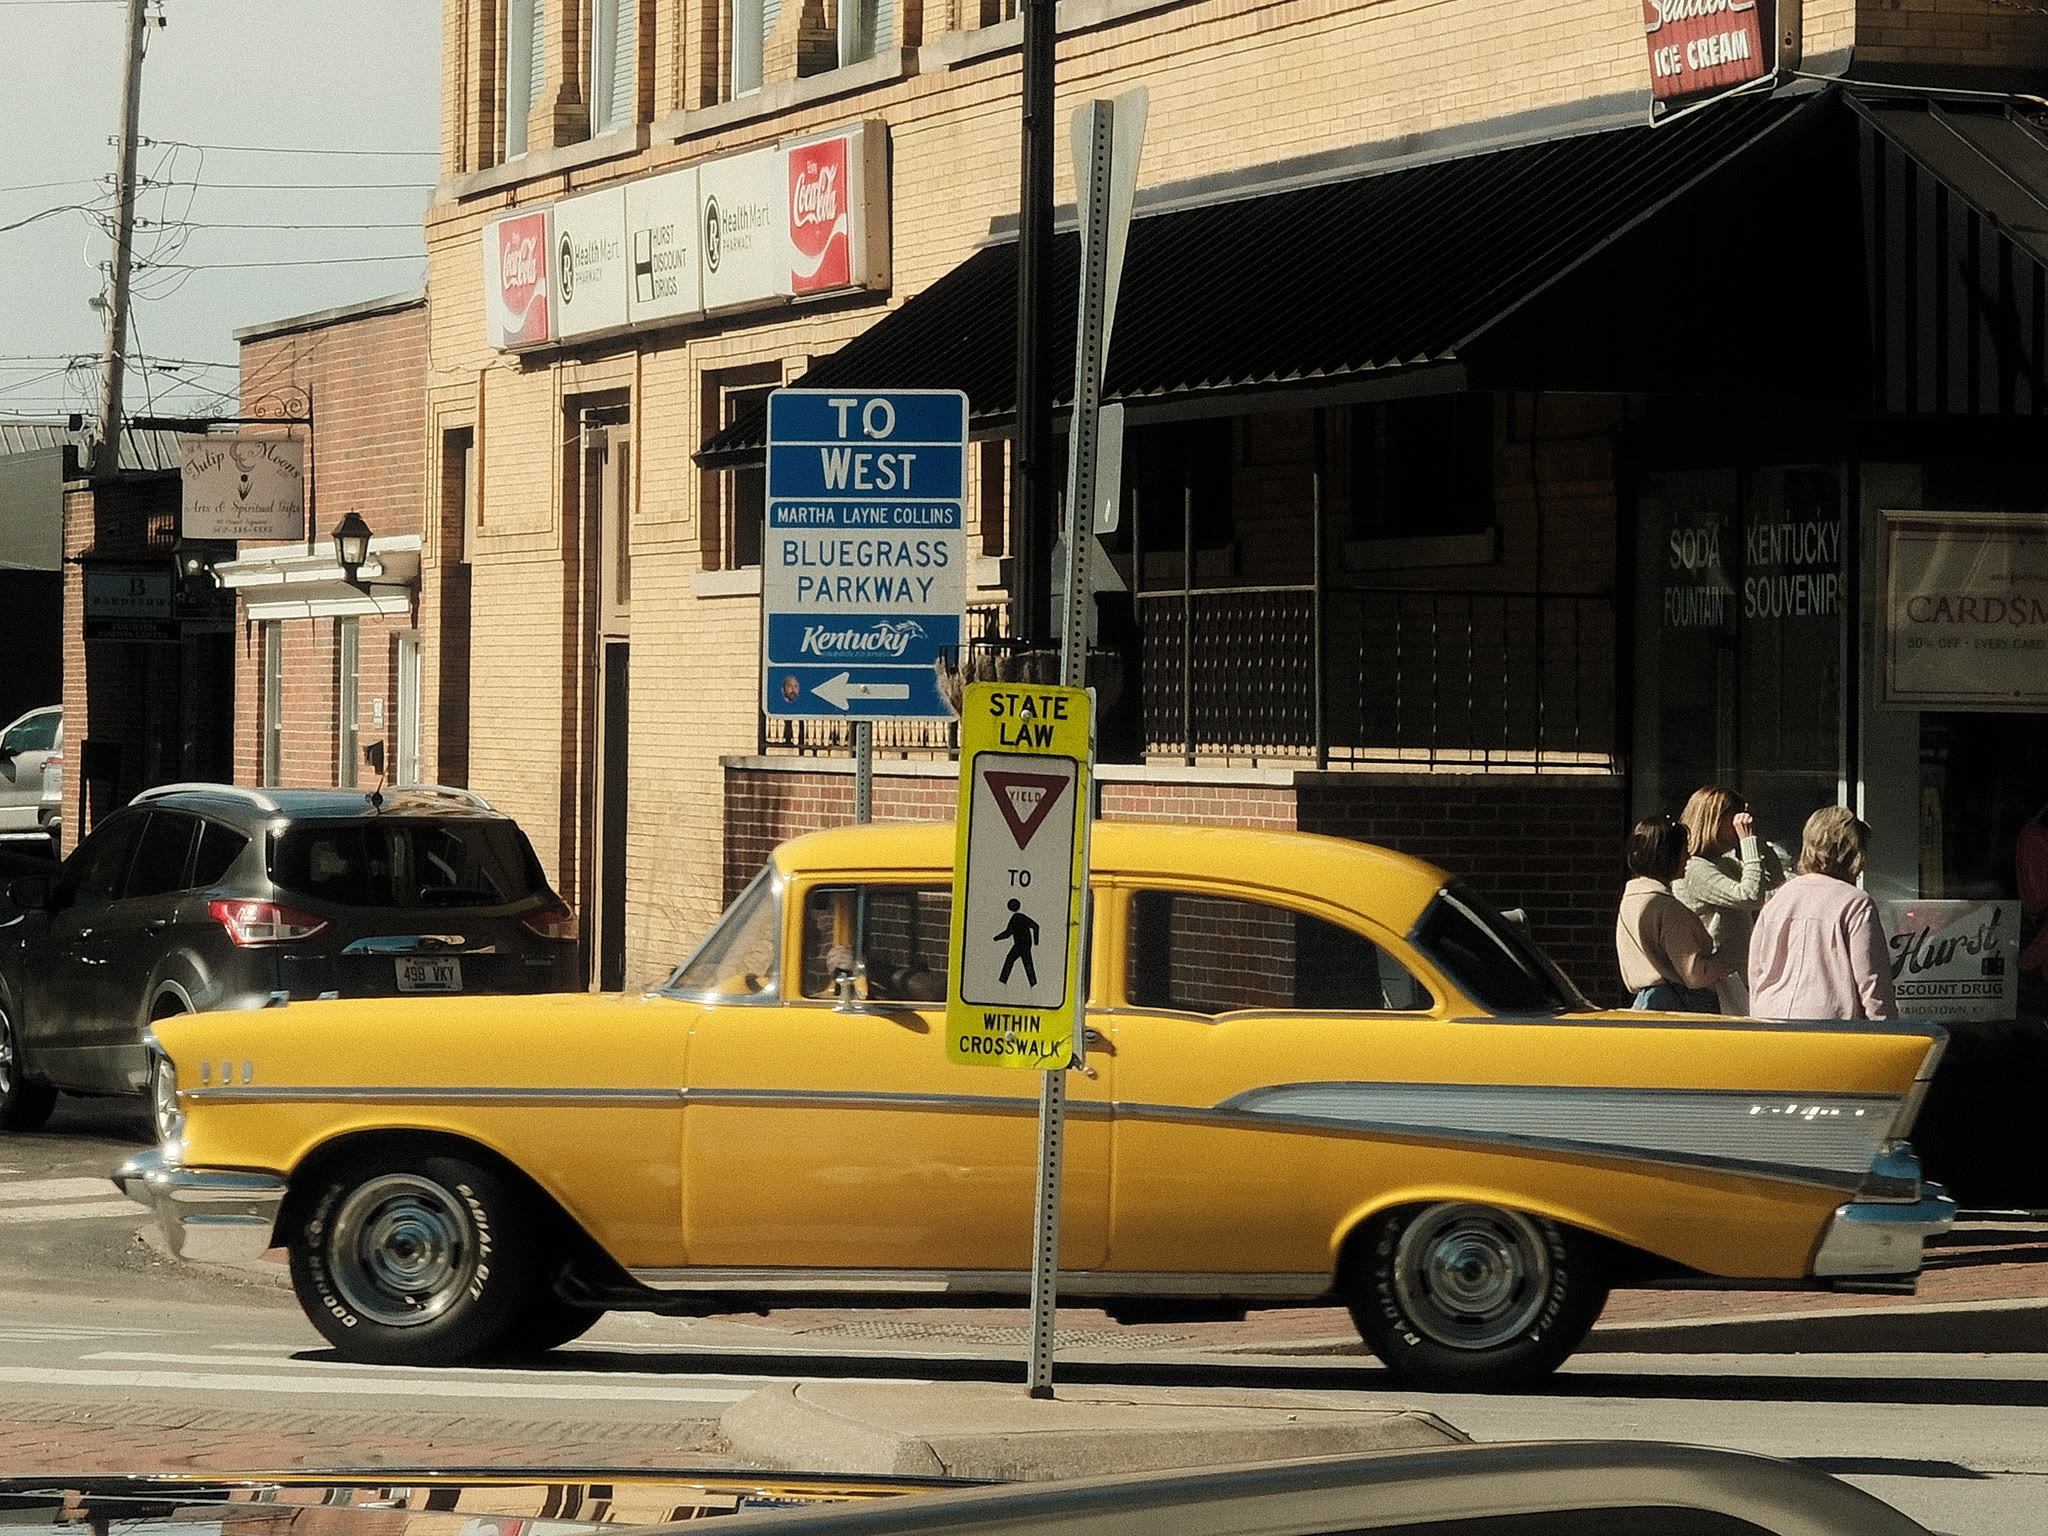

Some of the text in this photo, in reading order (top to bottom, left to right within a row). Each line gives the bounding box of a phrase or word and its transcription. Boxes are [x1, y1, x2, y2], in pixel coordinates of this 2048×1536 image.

[1654, 28, 1750, 78] ICE CREAM
[653, 224, 675, 246] HURST
[653, 248, 687, 273] DISCOUNT
[654, 276, 678, 299] DRUGS
[828, 398, 896, 439] TO
[185, 441, 301, 481] Tulip Moons
[777, 507, 953, 525] MARTHA LAYNE COLLINS
[783, 540, 949, 568] BLUEGRASS
[1669, 527, 1721, 570] SODA
[1747, 520, 1841, 566] KENTUCKY
[798, 576, 934, 603] PARKWAY
[1664, 586, 1725, 627] FOUNTAIN
[800, 624, 910, 657] Kentucky
[989, 692, 1068, 721] STATE
[999, 722, 1054, 748] LAW
[1008, 789, 1041, 804] YIELD
[1008, 868, 1031, 888] TO
[1890, 906, 2002, 981] Hurst
[1892, 983, 2003, 996] ISCOUNT DRUG
[984, 1013, 1040, 1033] WITHIN
[959, 1035, 1060, 1058] CROSSWALK
